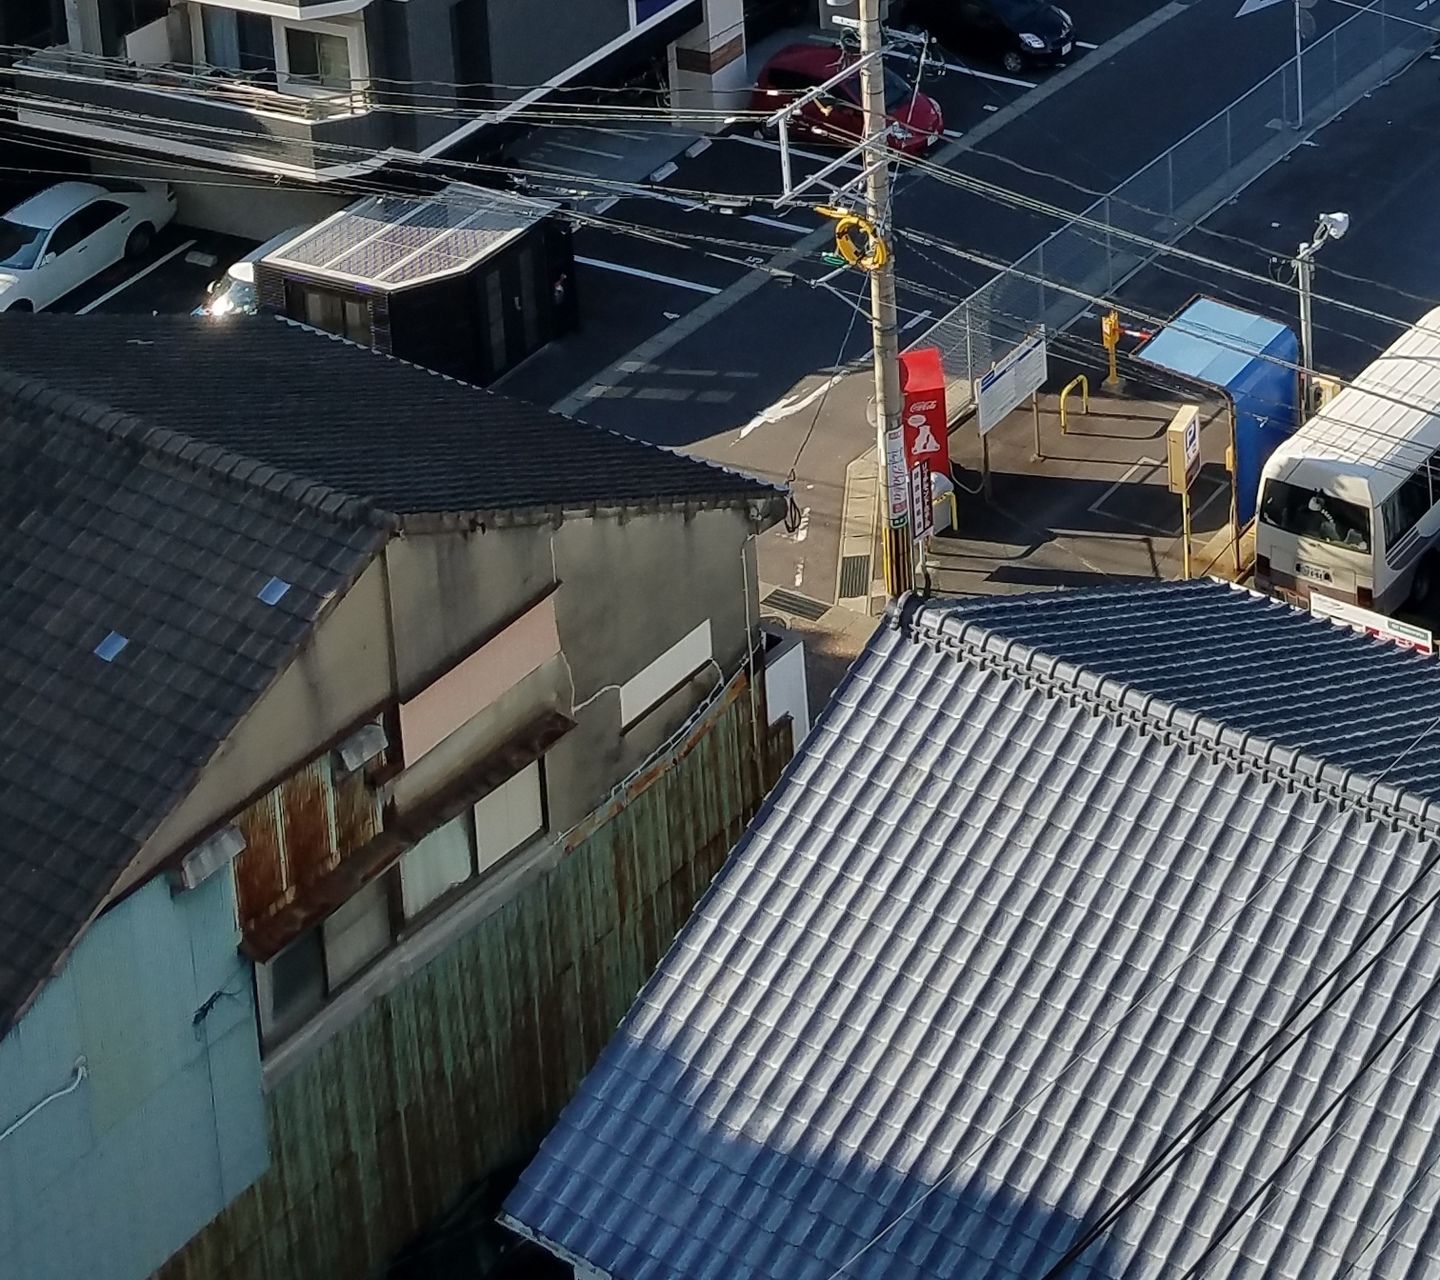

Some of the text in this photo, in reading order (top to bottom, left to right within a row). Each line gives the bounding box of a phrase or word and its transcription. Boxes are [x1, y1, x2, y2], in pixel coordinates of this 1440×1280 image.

[745, 255, 765, 265] 5
[662, 311, 681, 320] 4
[1187, 423, 1195, 449] P
